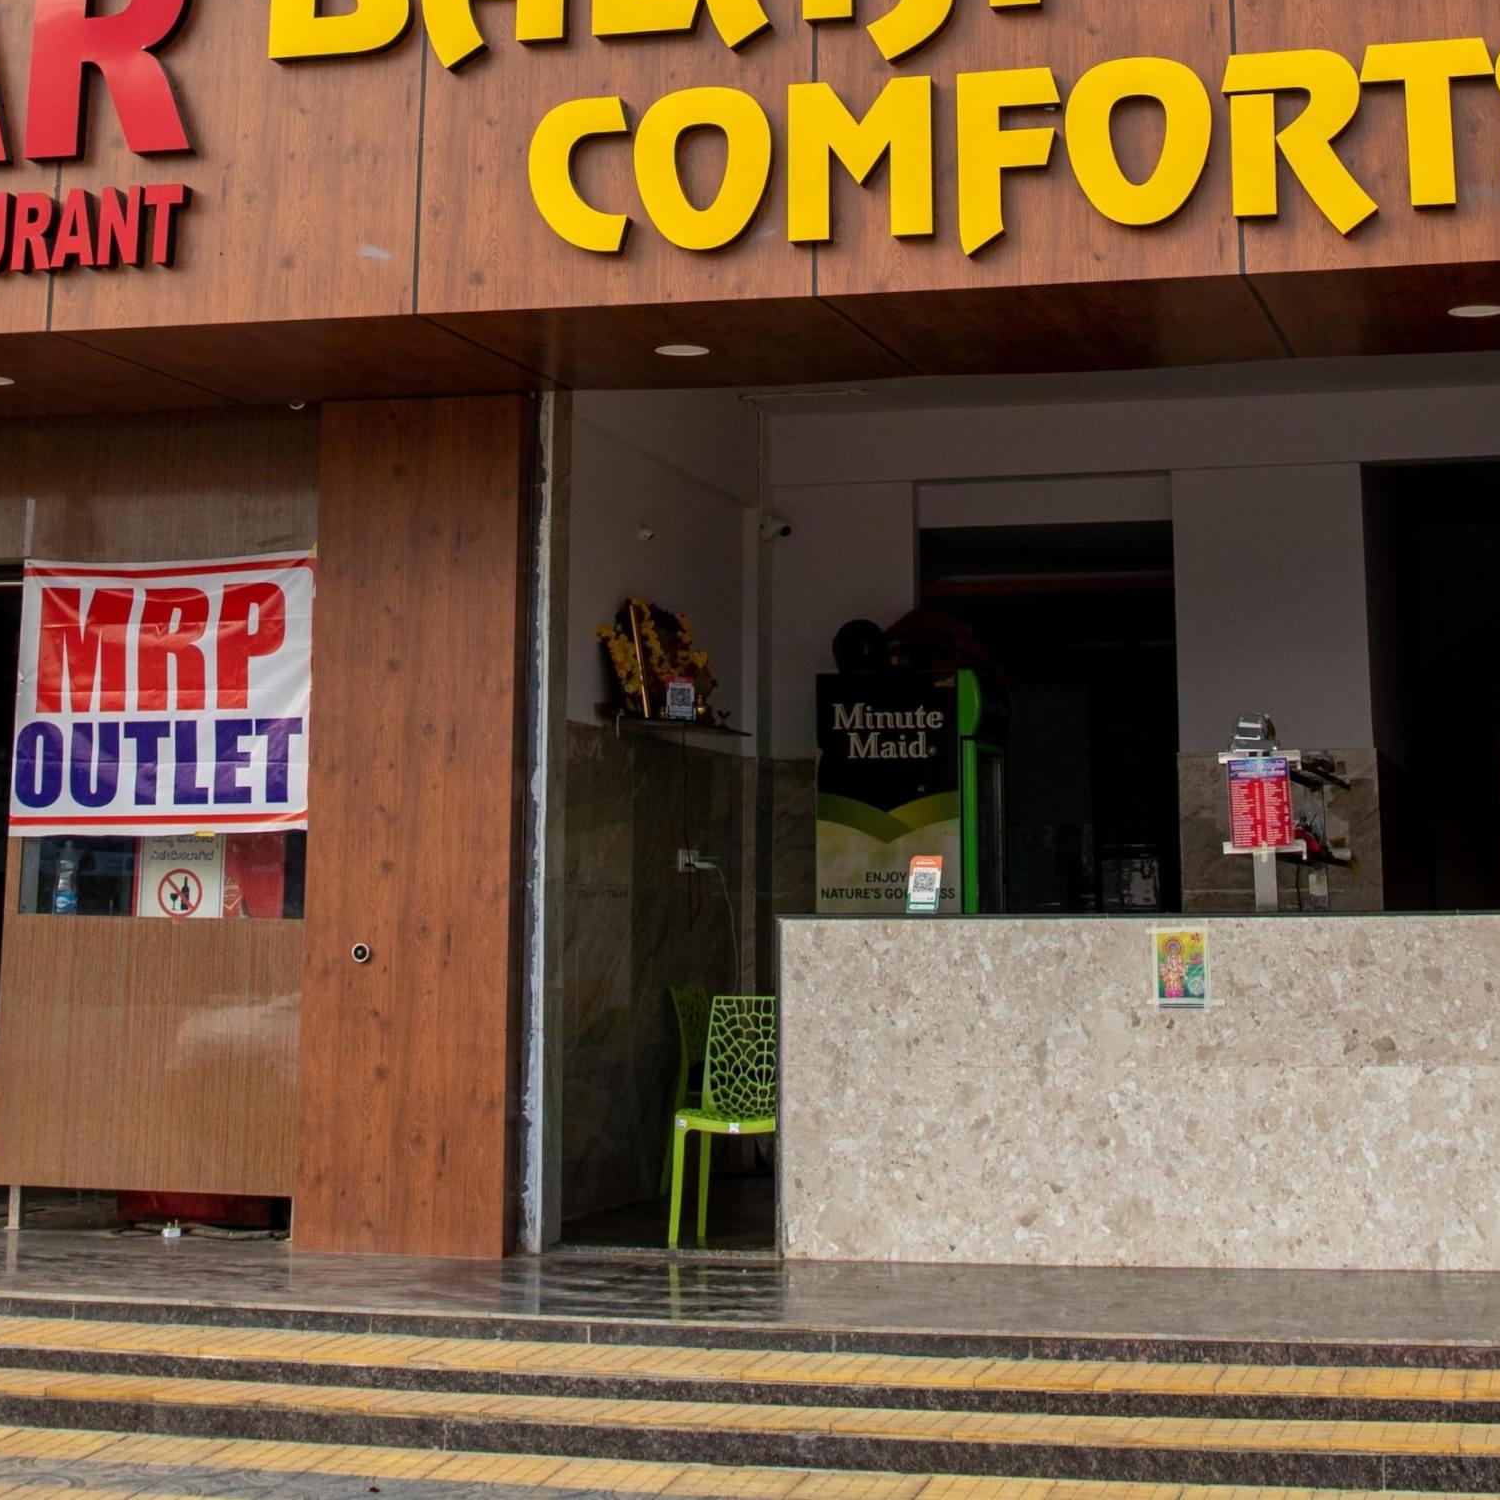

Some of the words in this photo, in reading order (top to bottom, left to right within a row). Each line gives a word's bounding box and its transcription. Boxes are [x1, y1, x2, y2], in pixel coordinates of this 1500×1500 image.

[35, 582, 286, 713] MRP
[832, 702, 944, 730] Minute
[847, 731, 929, 759] Maid
[14, 717, 303, 809] OUTLET
[865, 871, 907, 883] ENJOY
[821, 887, 882, 900] NATURE'S
[884, 887, 955, 900] GOSS
